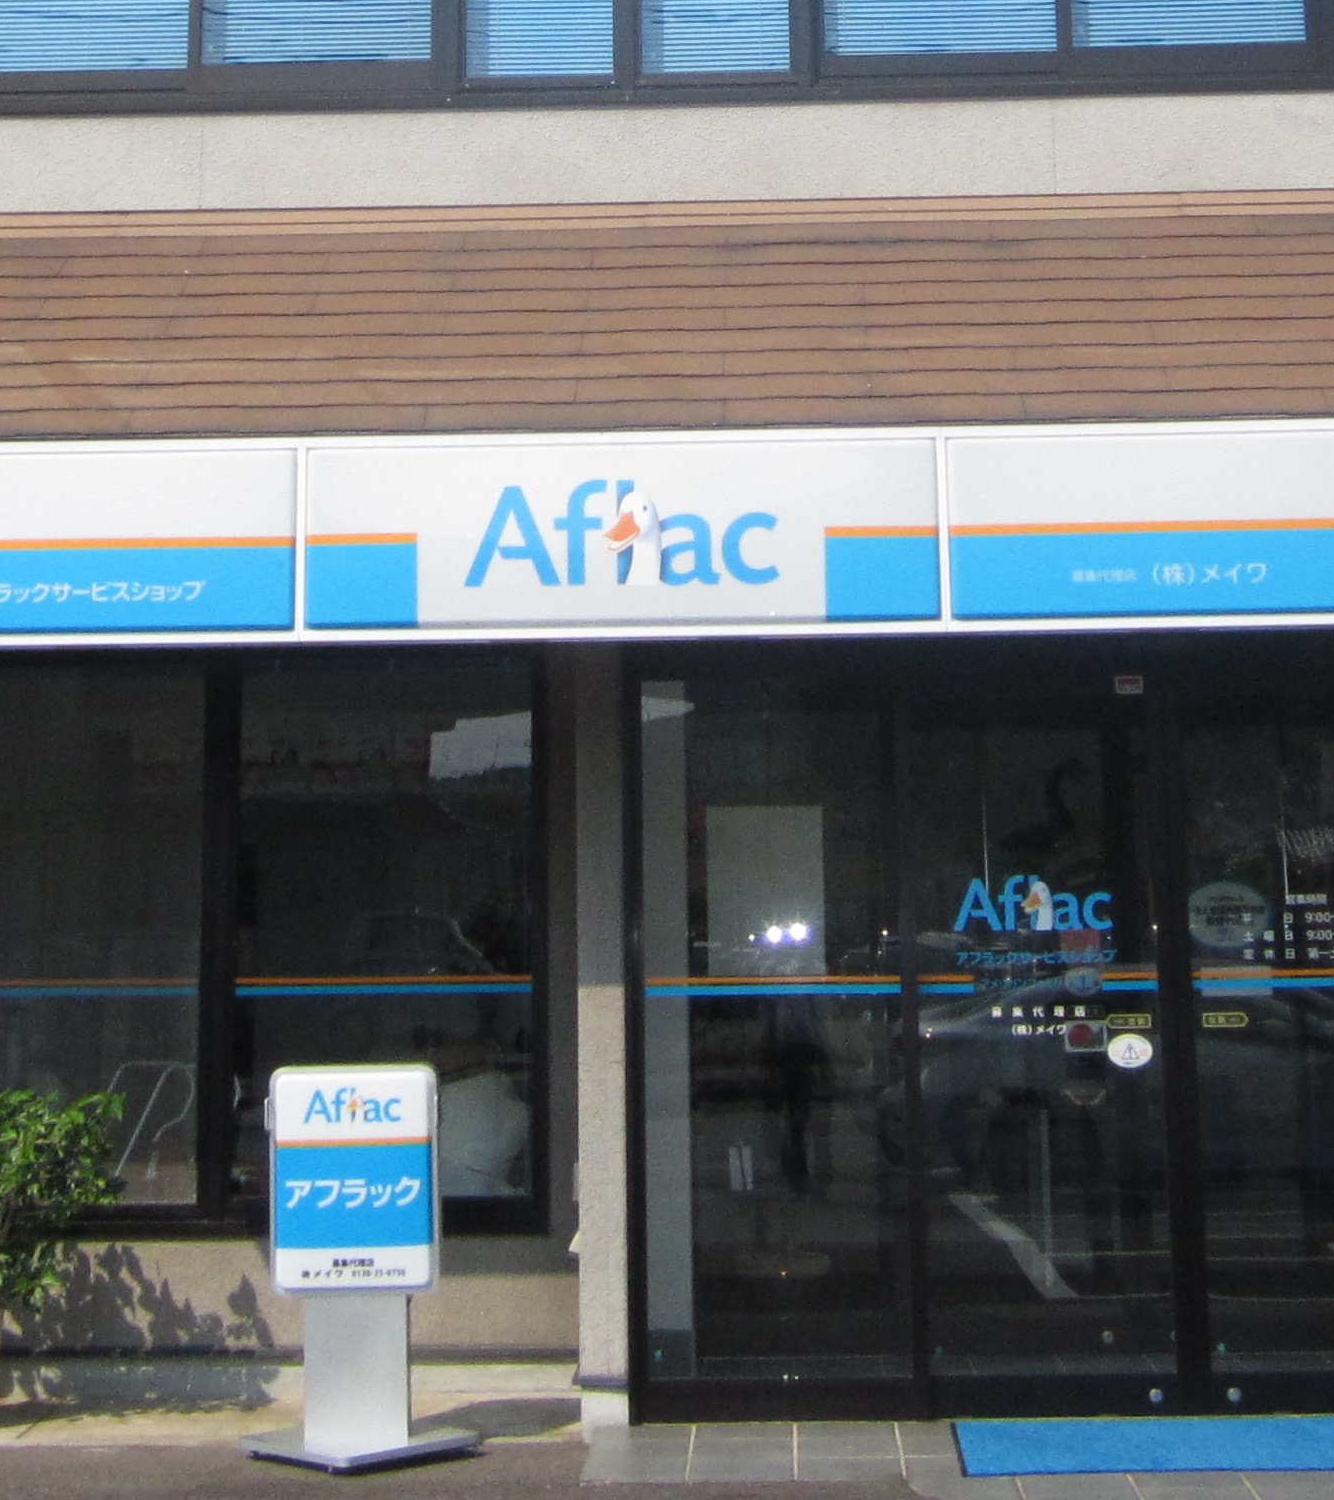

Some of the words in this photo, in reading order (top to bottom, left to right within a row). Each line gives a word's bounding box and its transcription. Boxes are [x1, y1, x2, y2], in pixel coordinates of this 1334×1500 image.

[464, 479, 779, 587] Aflac
[285, 1176, 421, 1208] アフラック
